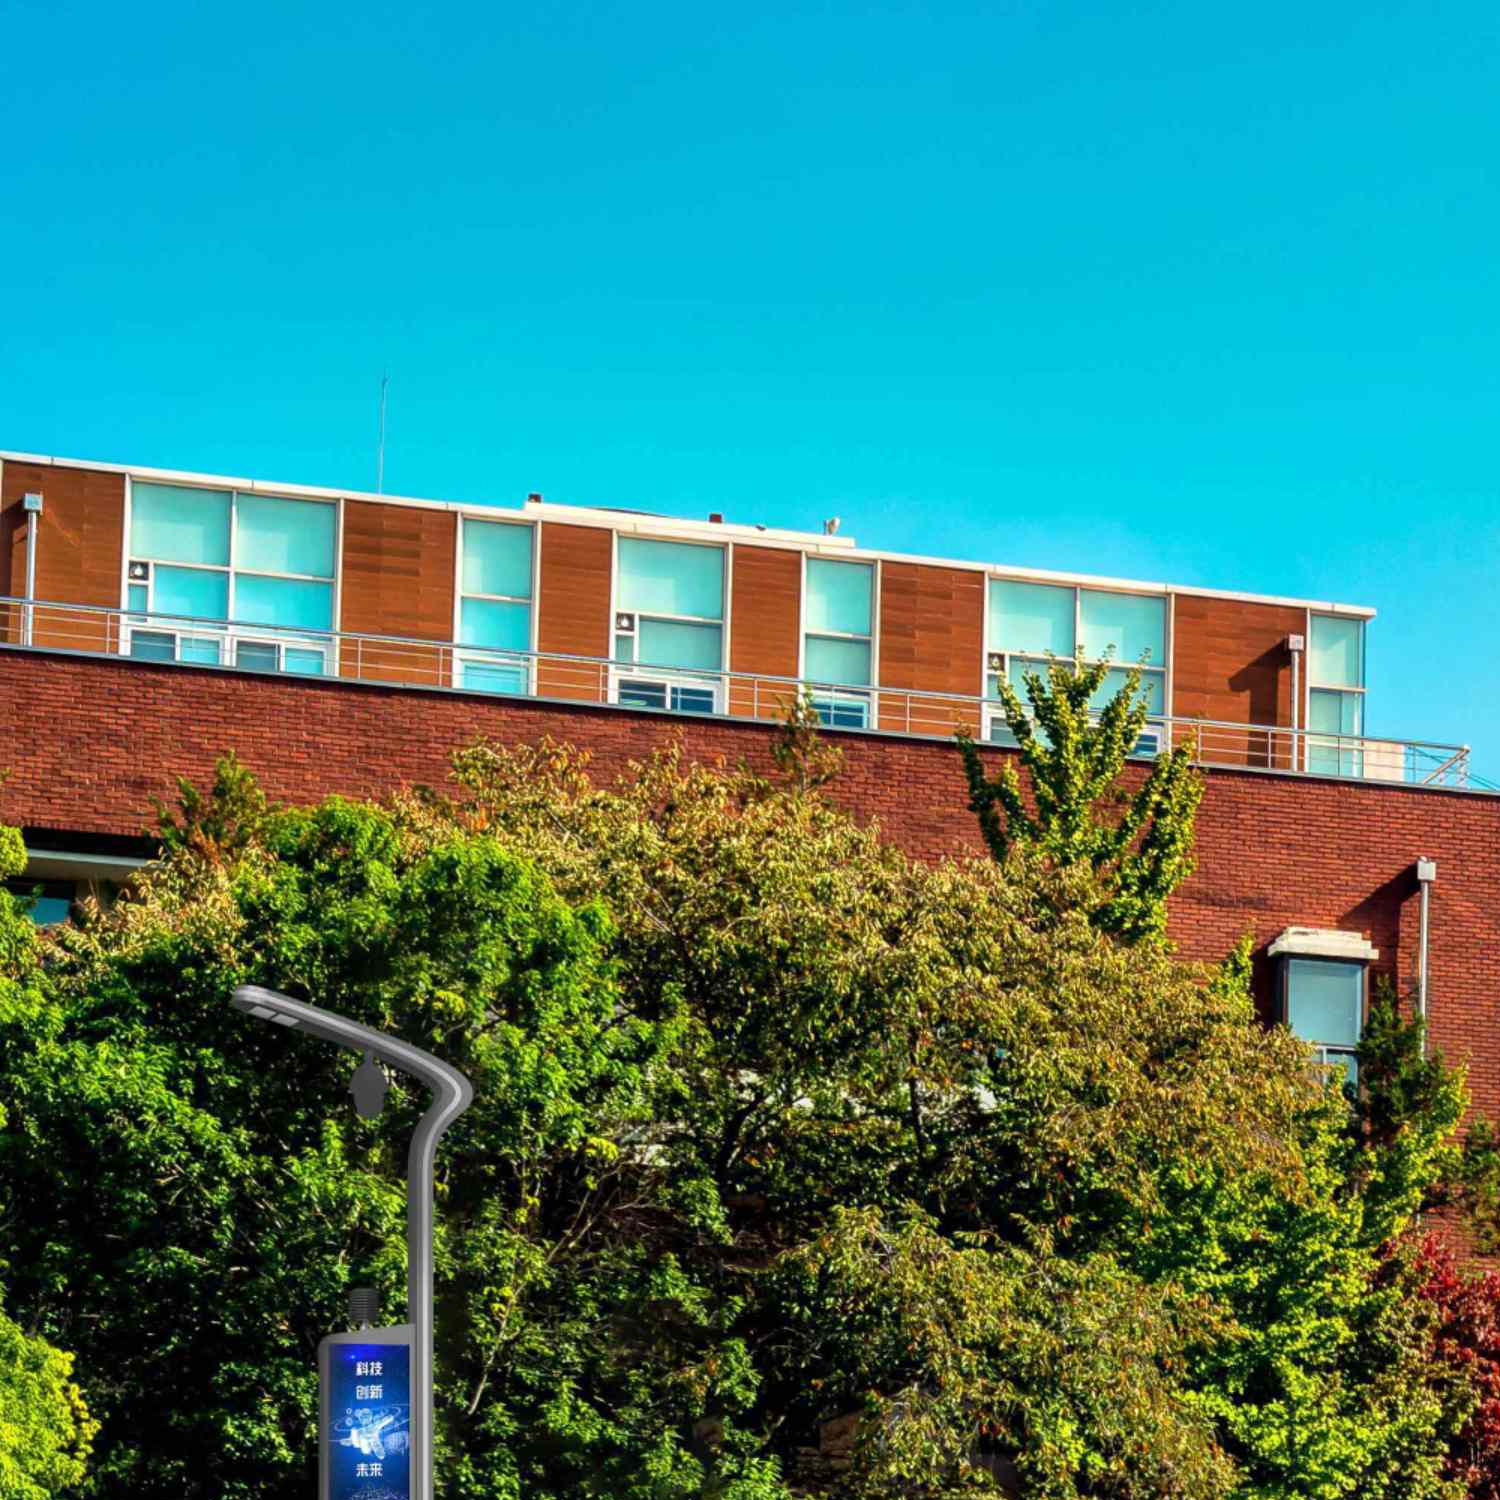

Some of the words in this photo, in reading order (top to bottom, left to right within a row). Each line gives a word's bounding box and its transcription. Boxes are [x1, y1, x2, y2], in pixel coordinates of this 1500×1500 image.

[356, 1361, 383, 1376] 科技
[356, 1385, 383, 1400] 创新
[356, 1463, 383, 1477] 未来
